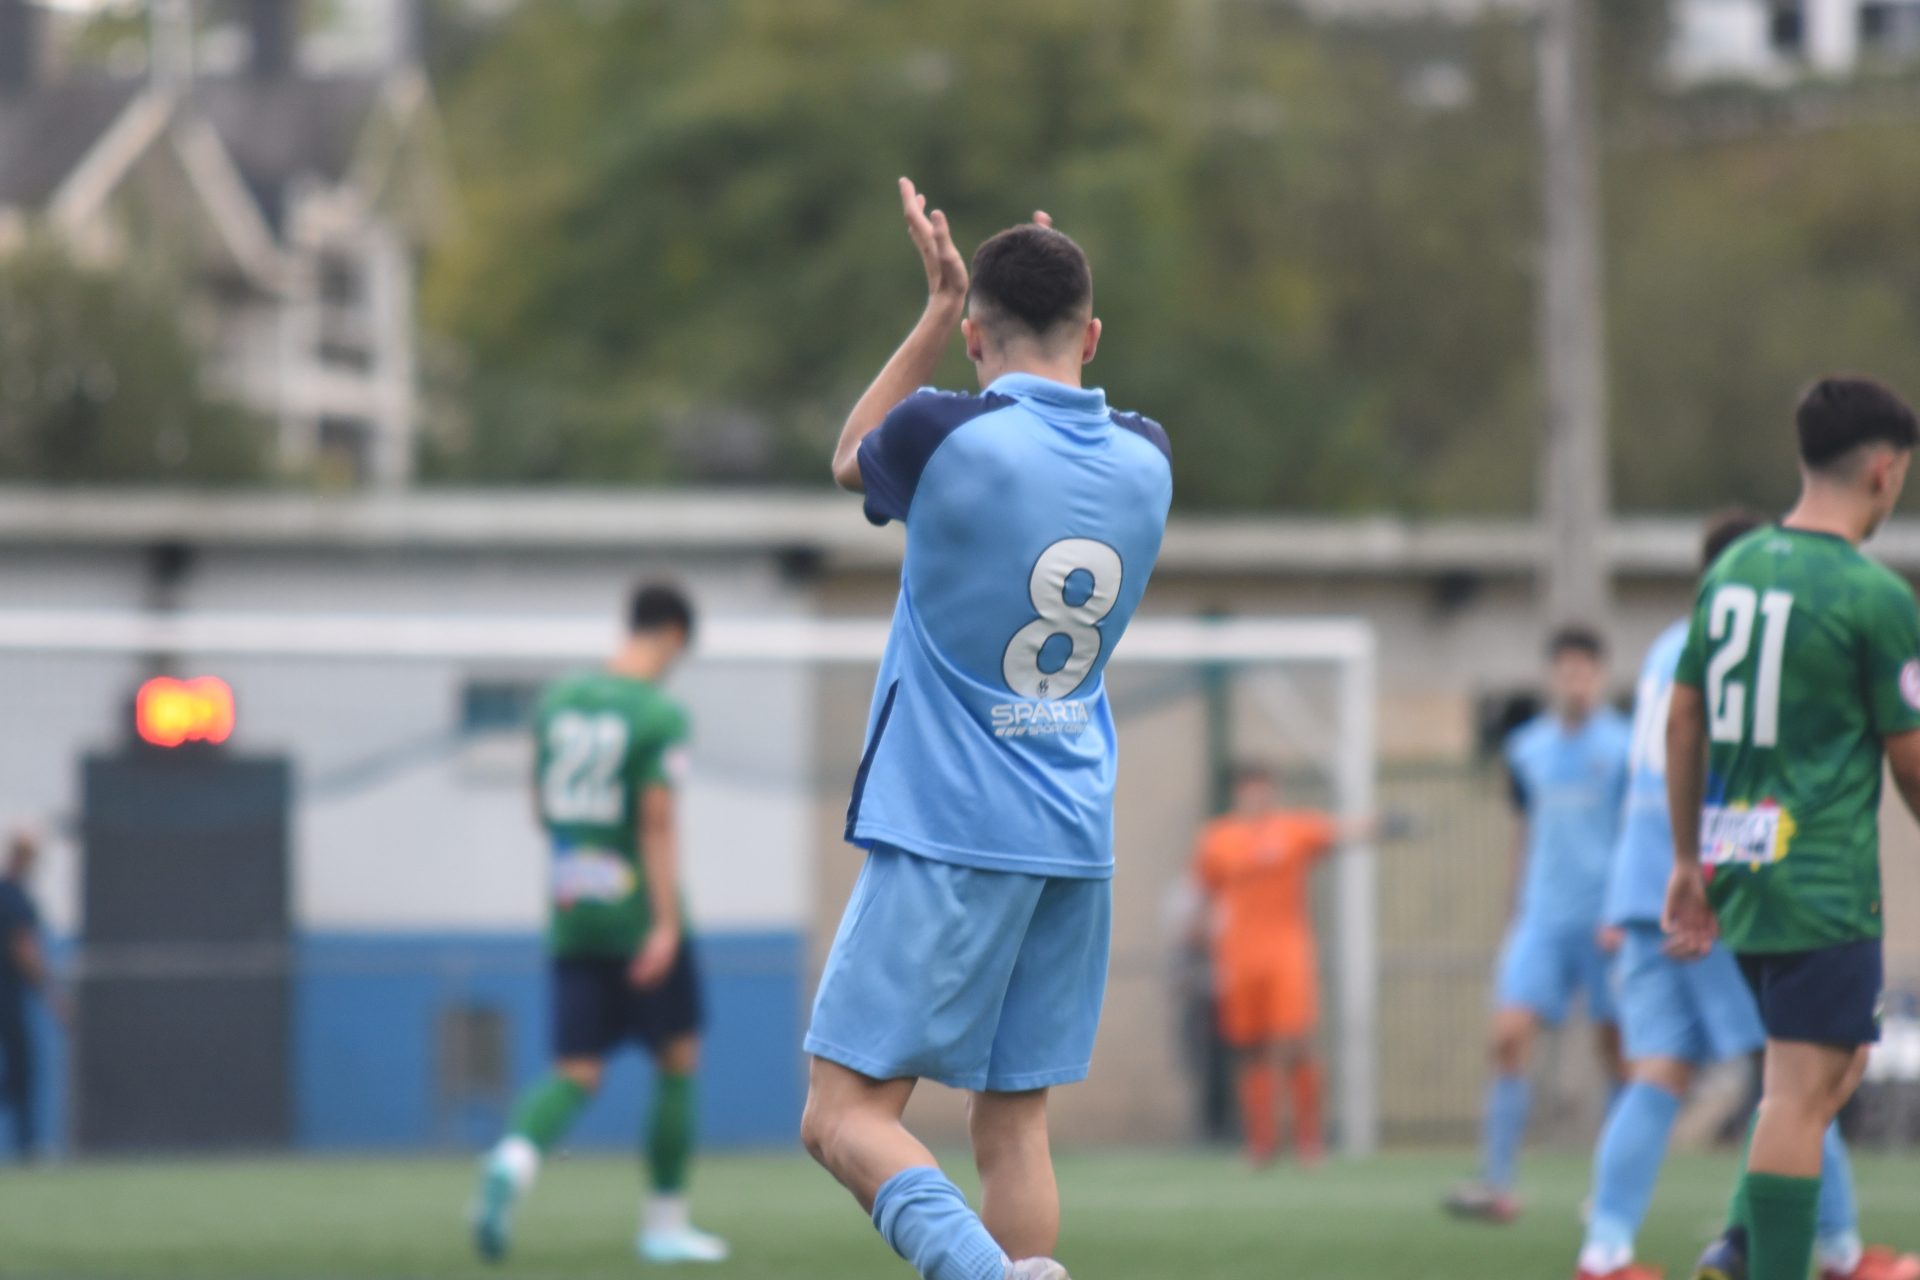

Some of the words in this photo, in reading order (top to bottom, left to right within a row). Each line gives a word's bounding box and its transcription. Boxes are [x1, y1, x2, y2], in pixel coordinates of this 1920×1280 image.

[1002, 537, 1123, 700] 8
[1707, 583, 1794, 747] 21
[547, 712, 628, 822] 22
[991, 701, 1088, 726] SPARTA
